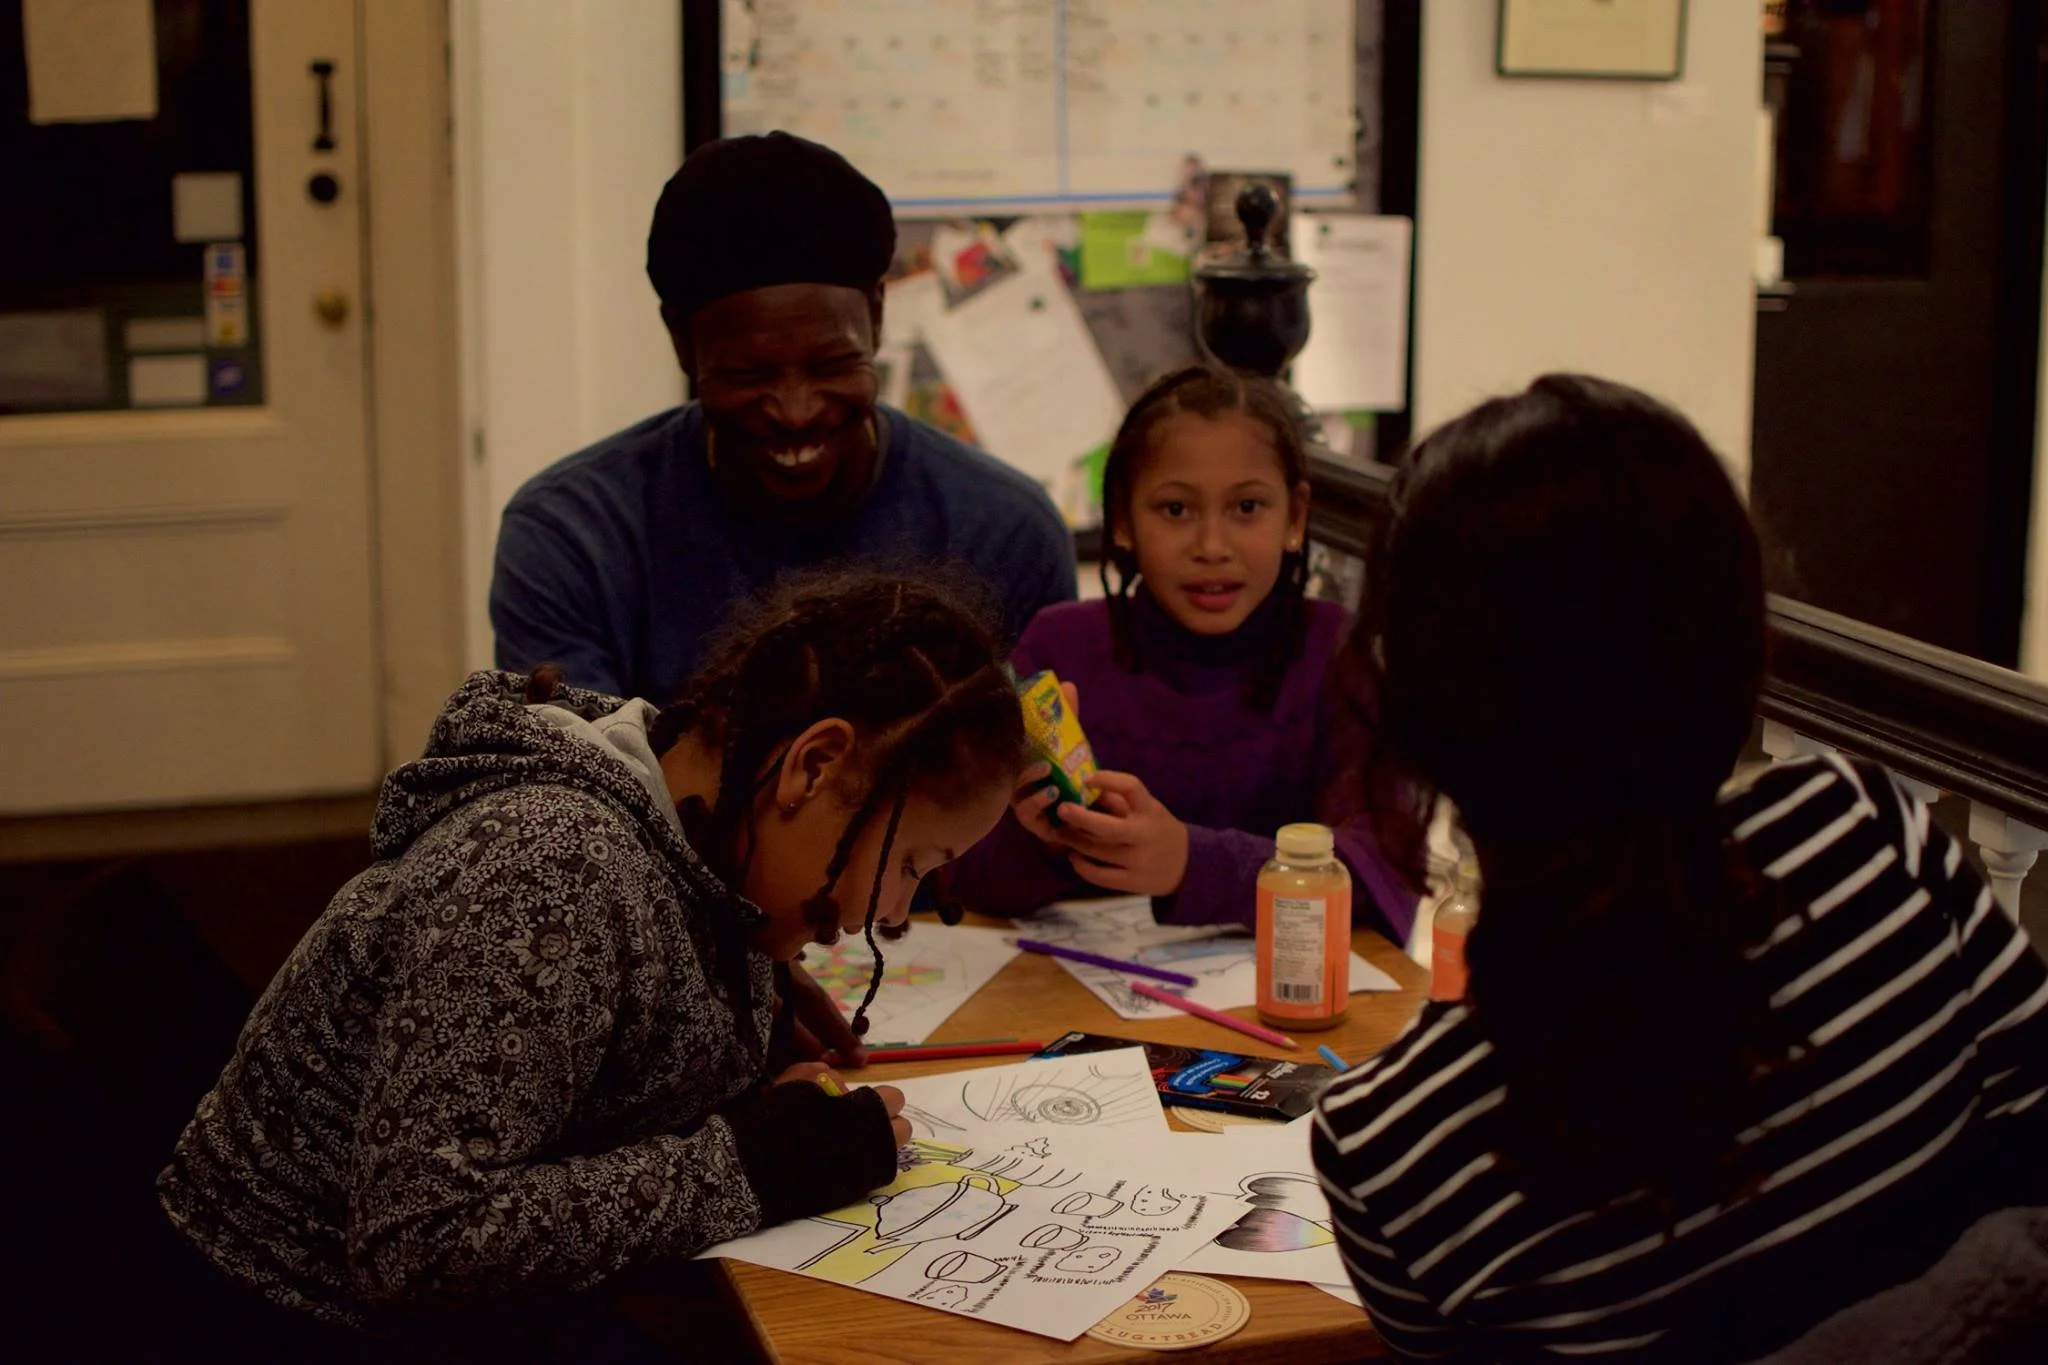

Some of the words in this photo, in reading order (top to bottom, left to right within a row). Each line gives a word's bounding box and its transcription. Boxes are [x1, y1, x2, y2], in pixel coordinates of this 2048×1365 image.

[1135, 1302, 1175, 1313] 2017
[1126, 1313, 1193, 1321] OTTAWA
[1162, 1323, 1222, 1341] TREAD
